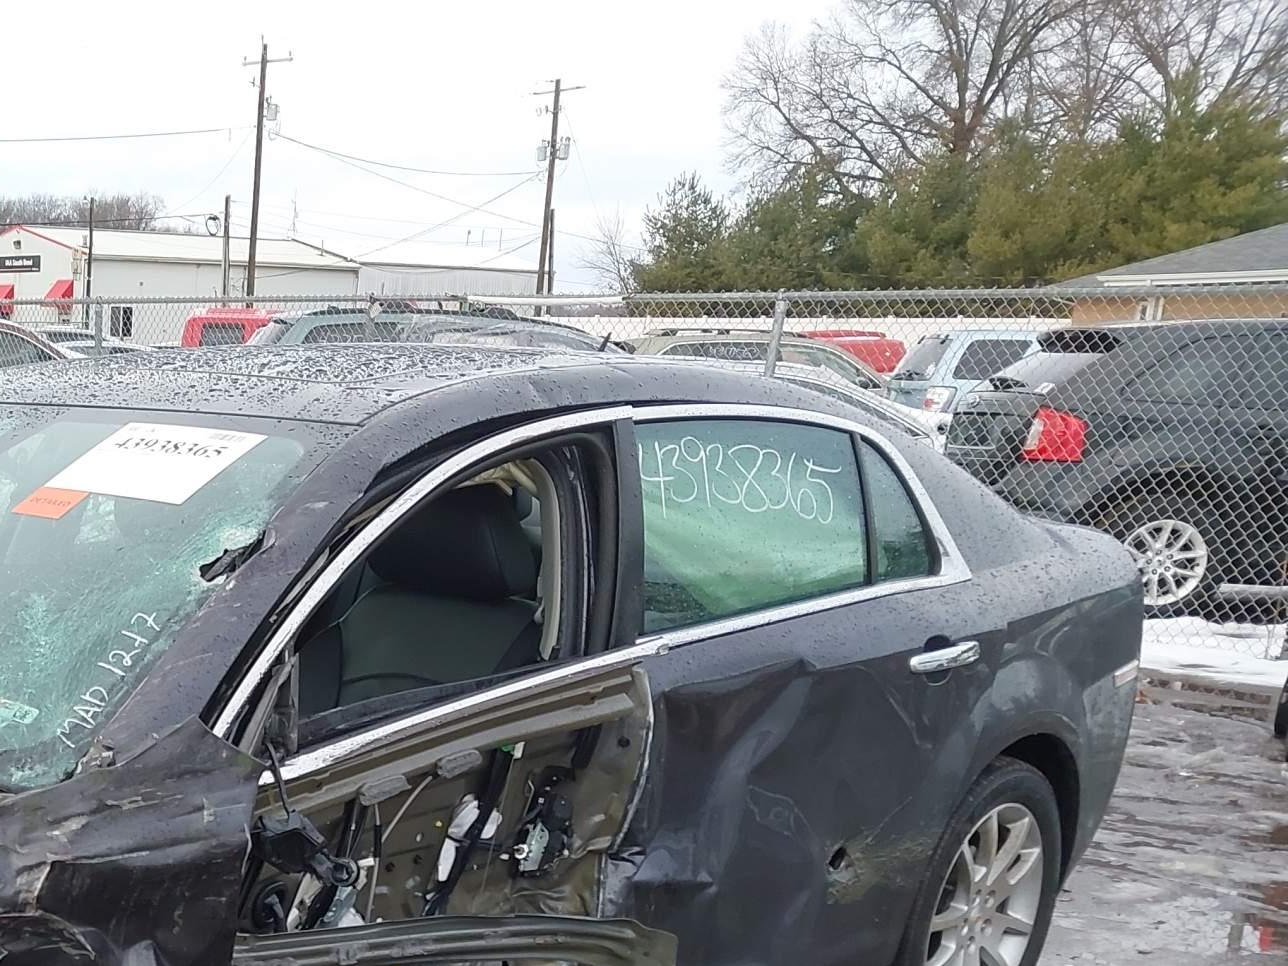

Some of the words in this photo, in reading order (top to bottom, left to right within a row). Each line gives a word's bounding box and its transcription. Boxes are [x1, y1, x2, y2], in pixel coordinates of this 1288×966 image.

[114, 437, 229, 459] 43938365
[638, 436, 843, 524] 43938365
[57, 686, 109, 748] MAD
